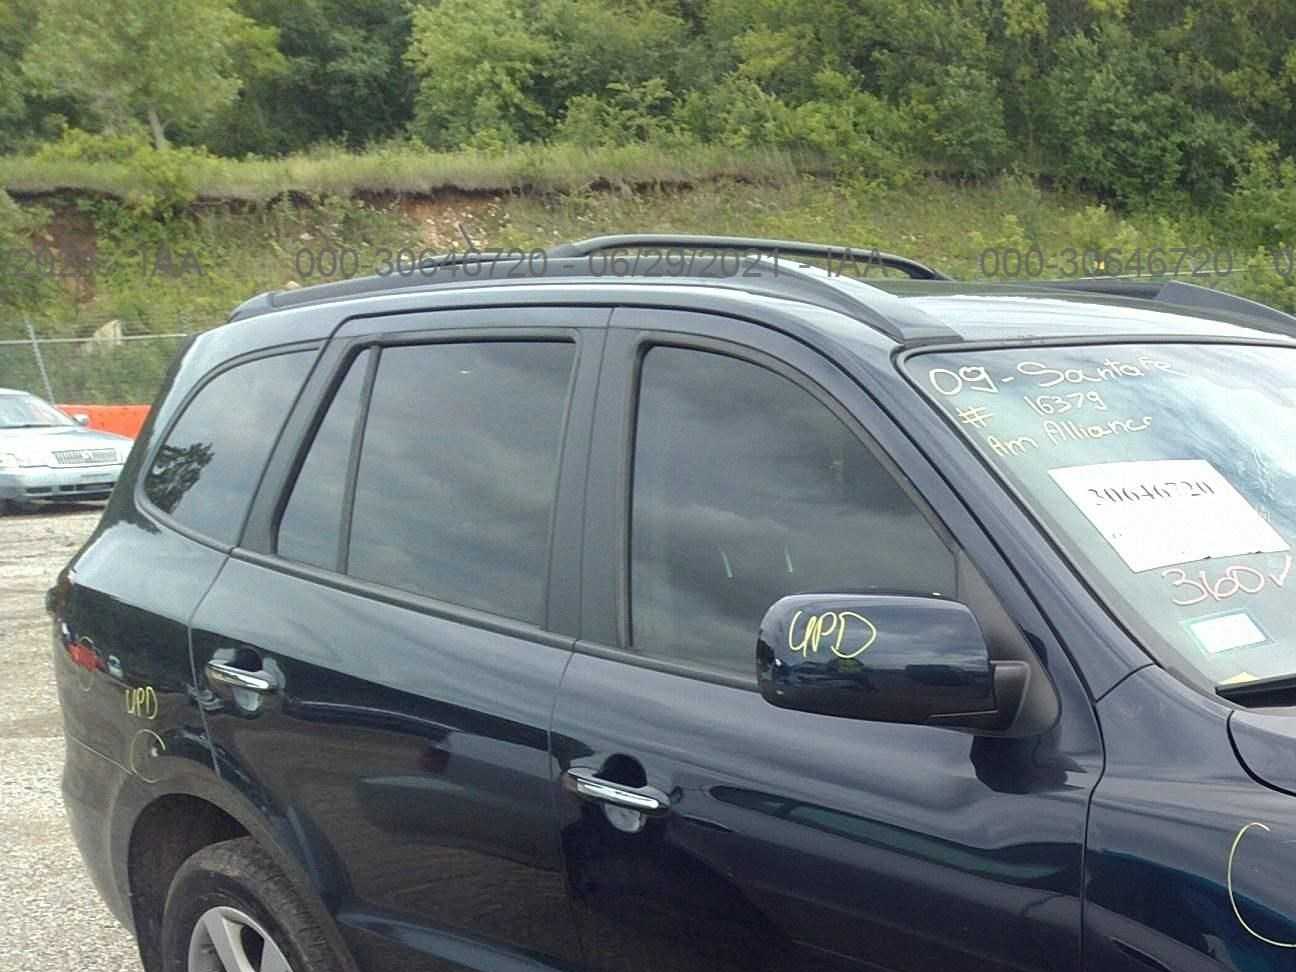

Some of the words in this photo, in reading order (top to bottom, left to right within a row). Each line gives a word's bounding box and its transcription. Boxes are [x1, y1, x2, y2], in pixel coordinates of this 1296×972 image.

[1023, 392, 1105, 416] 16379
[789, 610, 877, 658] UPD
[125, 686, 159, 720] UPD
